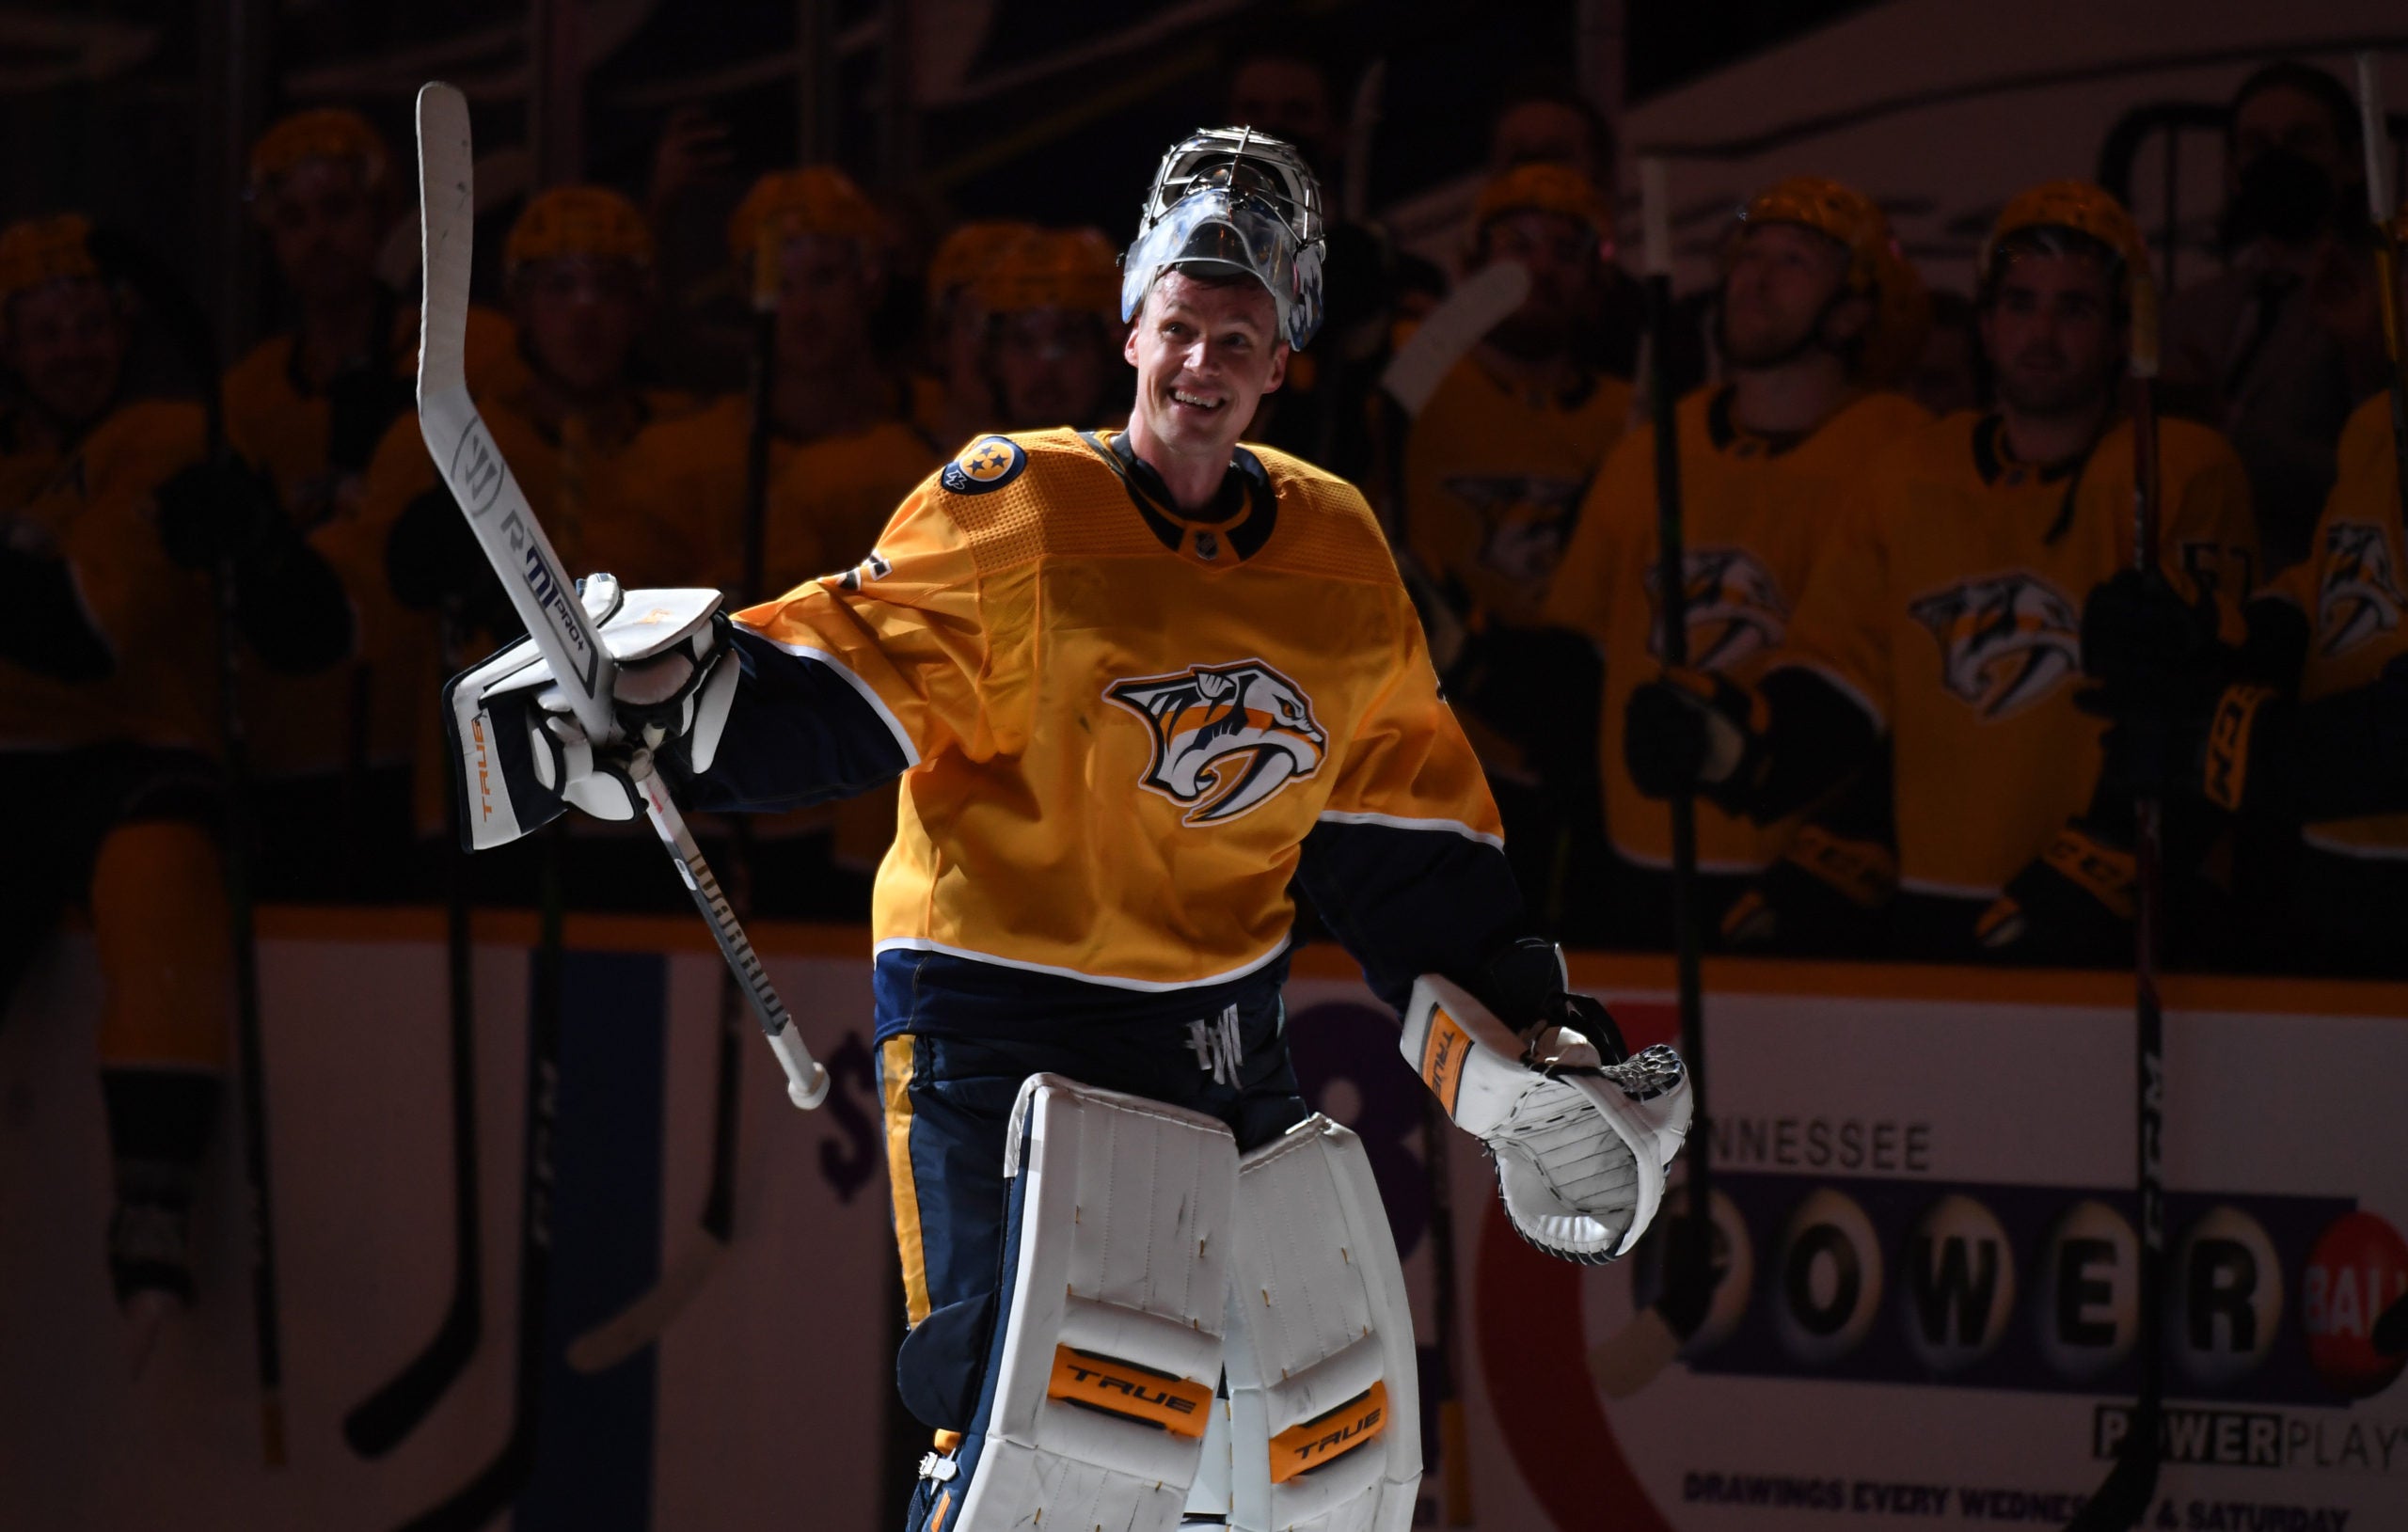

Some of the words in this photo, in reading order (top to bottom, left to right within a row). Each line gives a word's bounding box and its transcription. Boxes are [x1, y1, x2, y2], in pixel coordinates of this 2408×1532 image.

[471, 718, 493, 823] TRUE
[1433, 1031, 1455, 1098] TRUE
[1707, 1117, 1931, 1172] NNESSEE
[1667, 1217, 2258, 1351] OWER
[2304, 1262, 2408, 1338] BAL
[1067, 1364, 1197, 1414] TRUE
[1294, 1407, 1381, 1459] TRUE
[1685, 1473, 1846, 1513] DRAWINGS
[1852, 1480, 1950, 1518] EVERY
